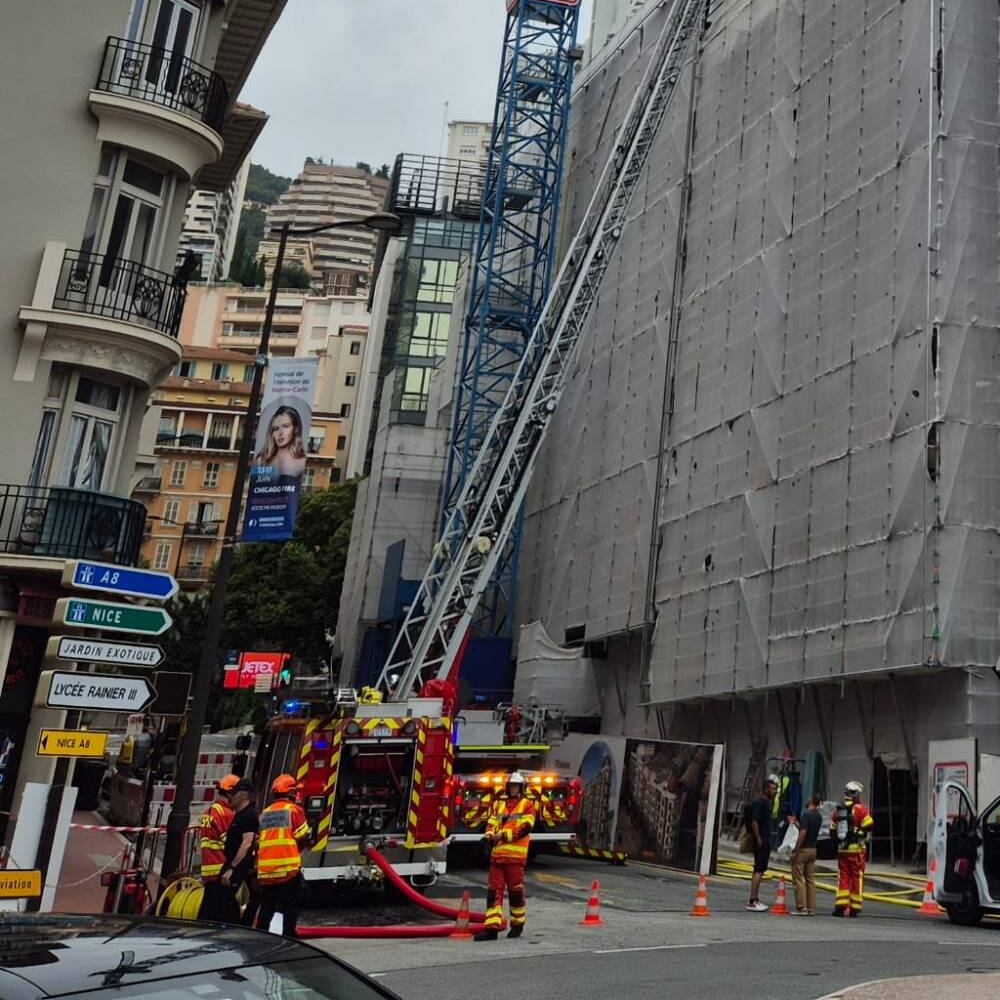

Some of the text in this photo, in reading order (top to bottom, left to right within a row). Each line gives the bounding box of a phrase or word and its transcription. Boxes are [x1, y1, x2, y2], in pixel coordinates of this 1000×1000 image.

[253, 485, 281, 494] CHICAGO
[100, 570, 120, 585] A8
[92, 608, 122, 623] NICE
[63, 644, 156, 661] JARDIN EXOTIQUE
[241, 661, 275, 674] JETEX
[54, 681, 138, 700] LYCÉE RAINIER III
[56, 738, 91, 748] NICE A8
